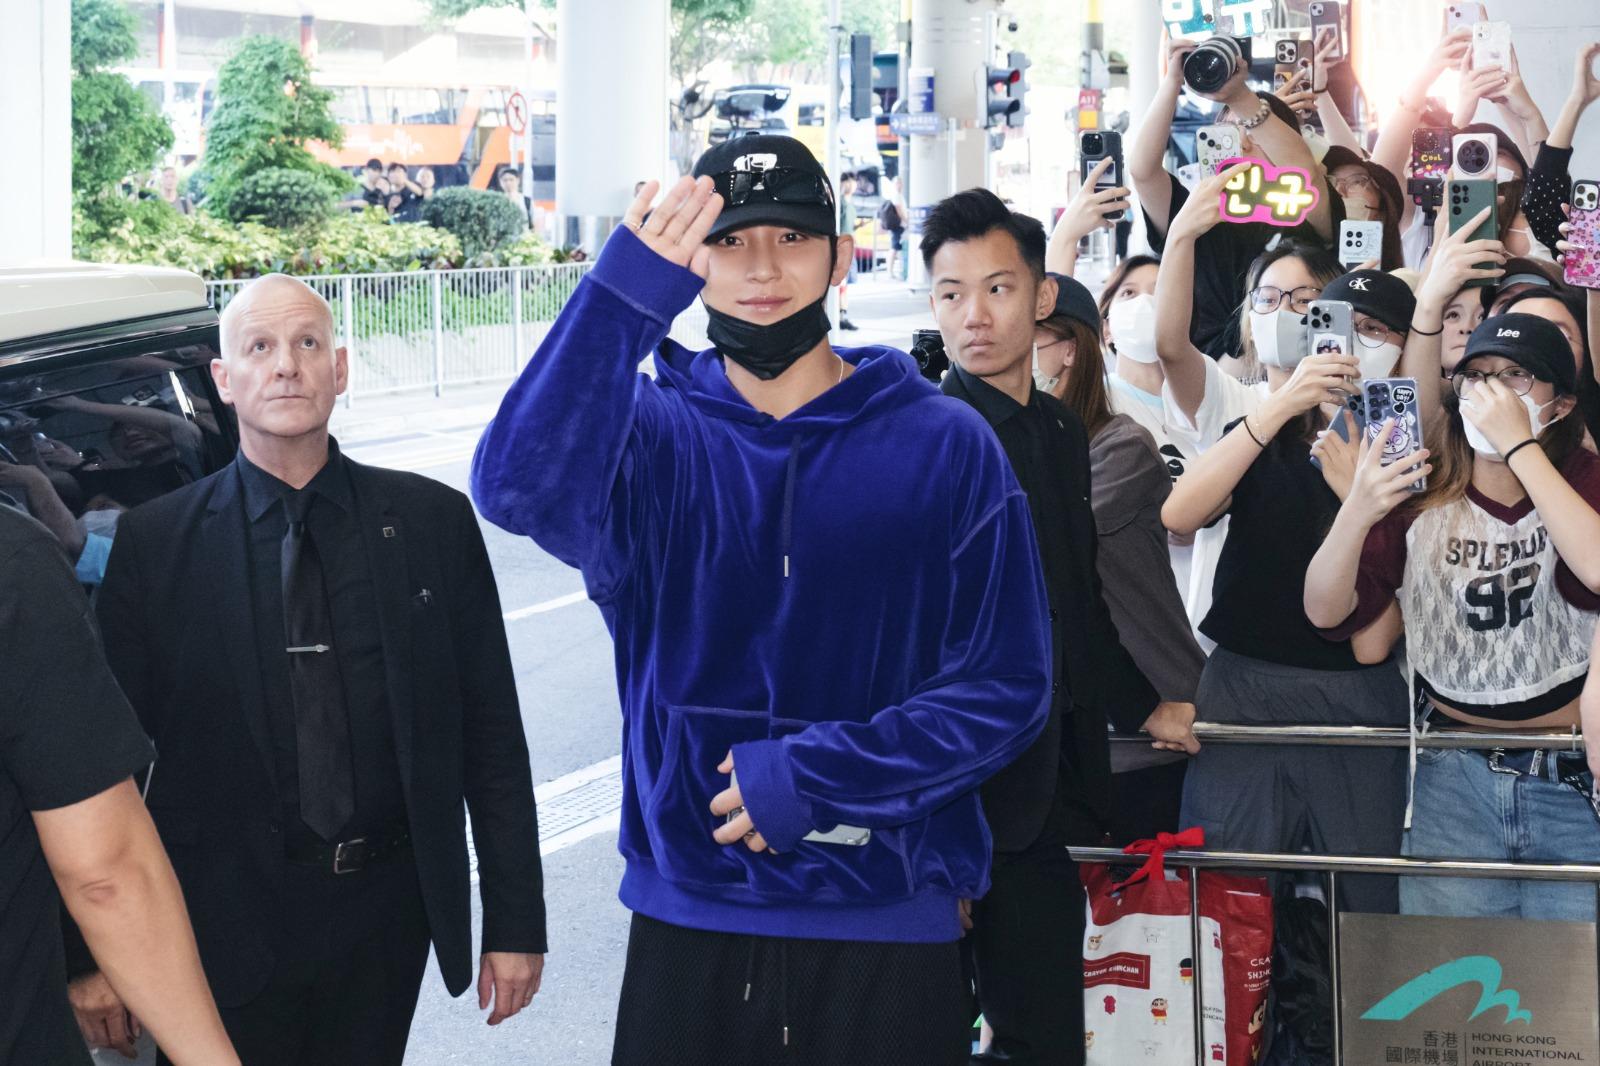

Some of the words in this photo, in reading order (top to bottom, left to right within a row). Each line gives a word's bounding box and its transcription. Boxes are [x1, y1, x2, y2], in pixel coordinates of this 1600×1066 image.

[1225, 165, 1313, 216] 민규
[1496, 327, 1520, 338] Lee
[1465, 562, 1542, 632] 92
[1250, 956, 1273, 967] CRA
[1422, 1030, 1458, 1048] 香港
[1472, 1032, 1513, 1043] HONG
[1517, 1035, 1556, 1045] KONG
[1386, 1046, 1458, 1066] 國際機場
[1472, 1046, 1584, 1061] INTERNATIONAL
